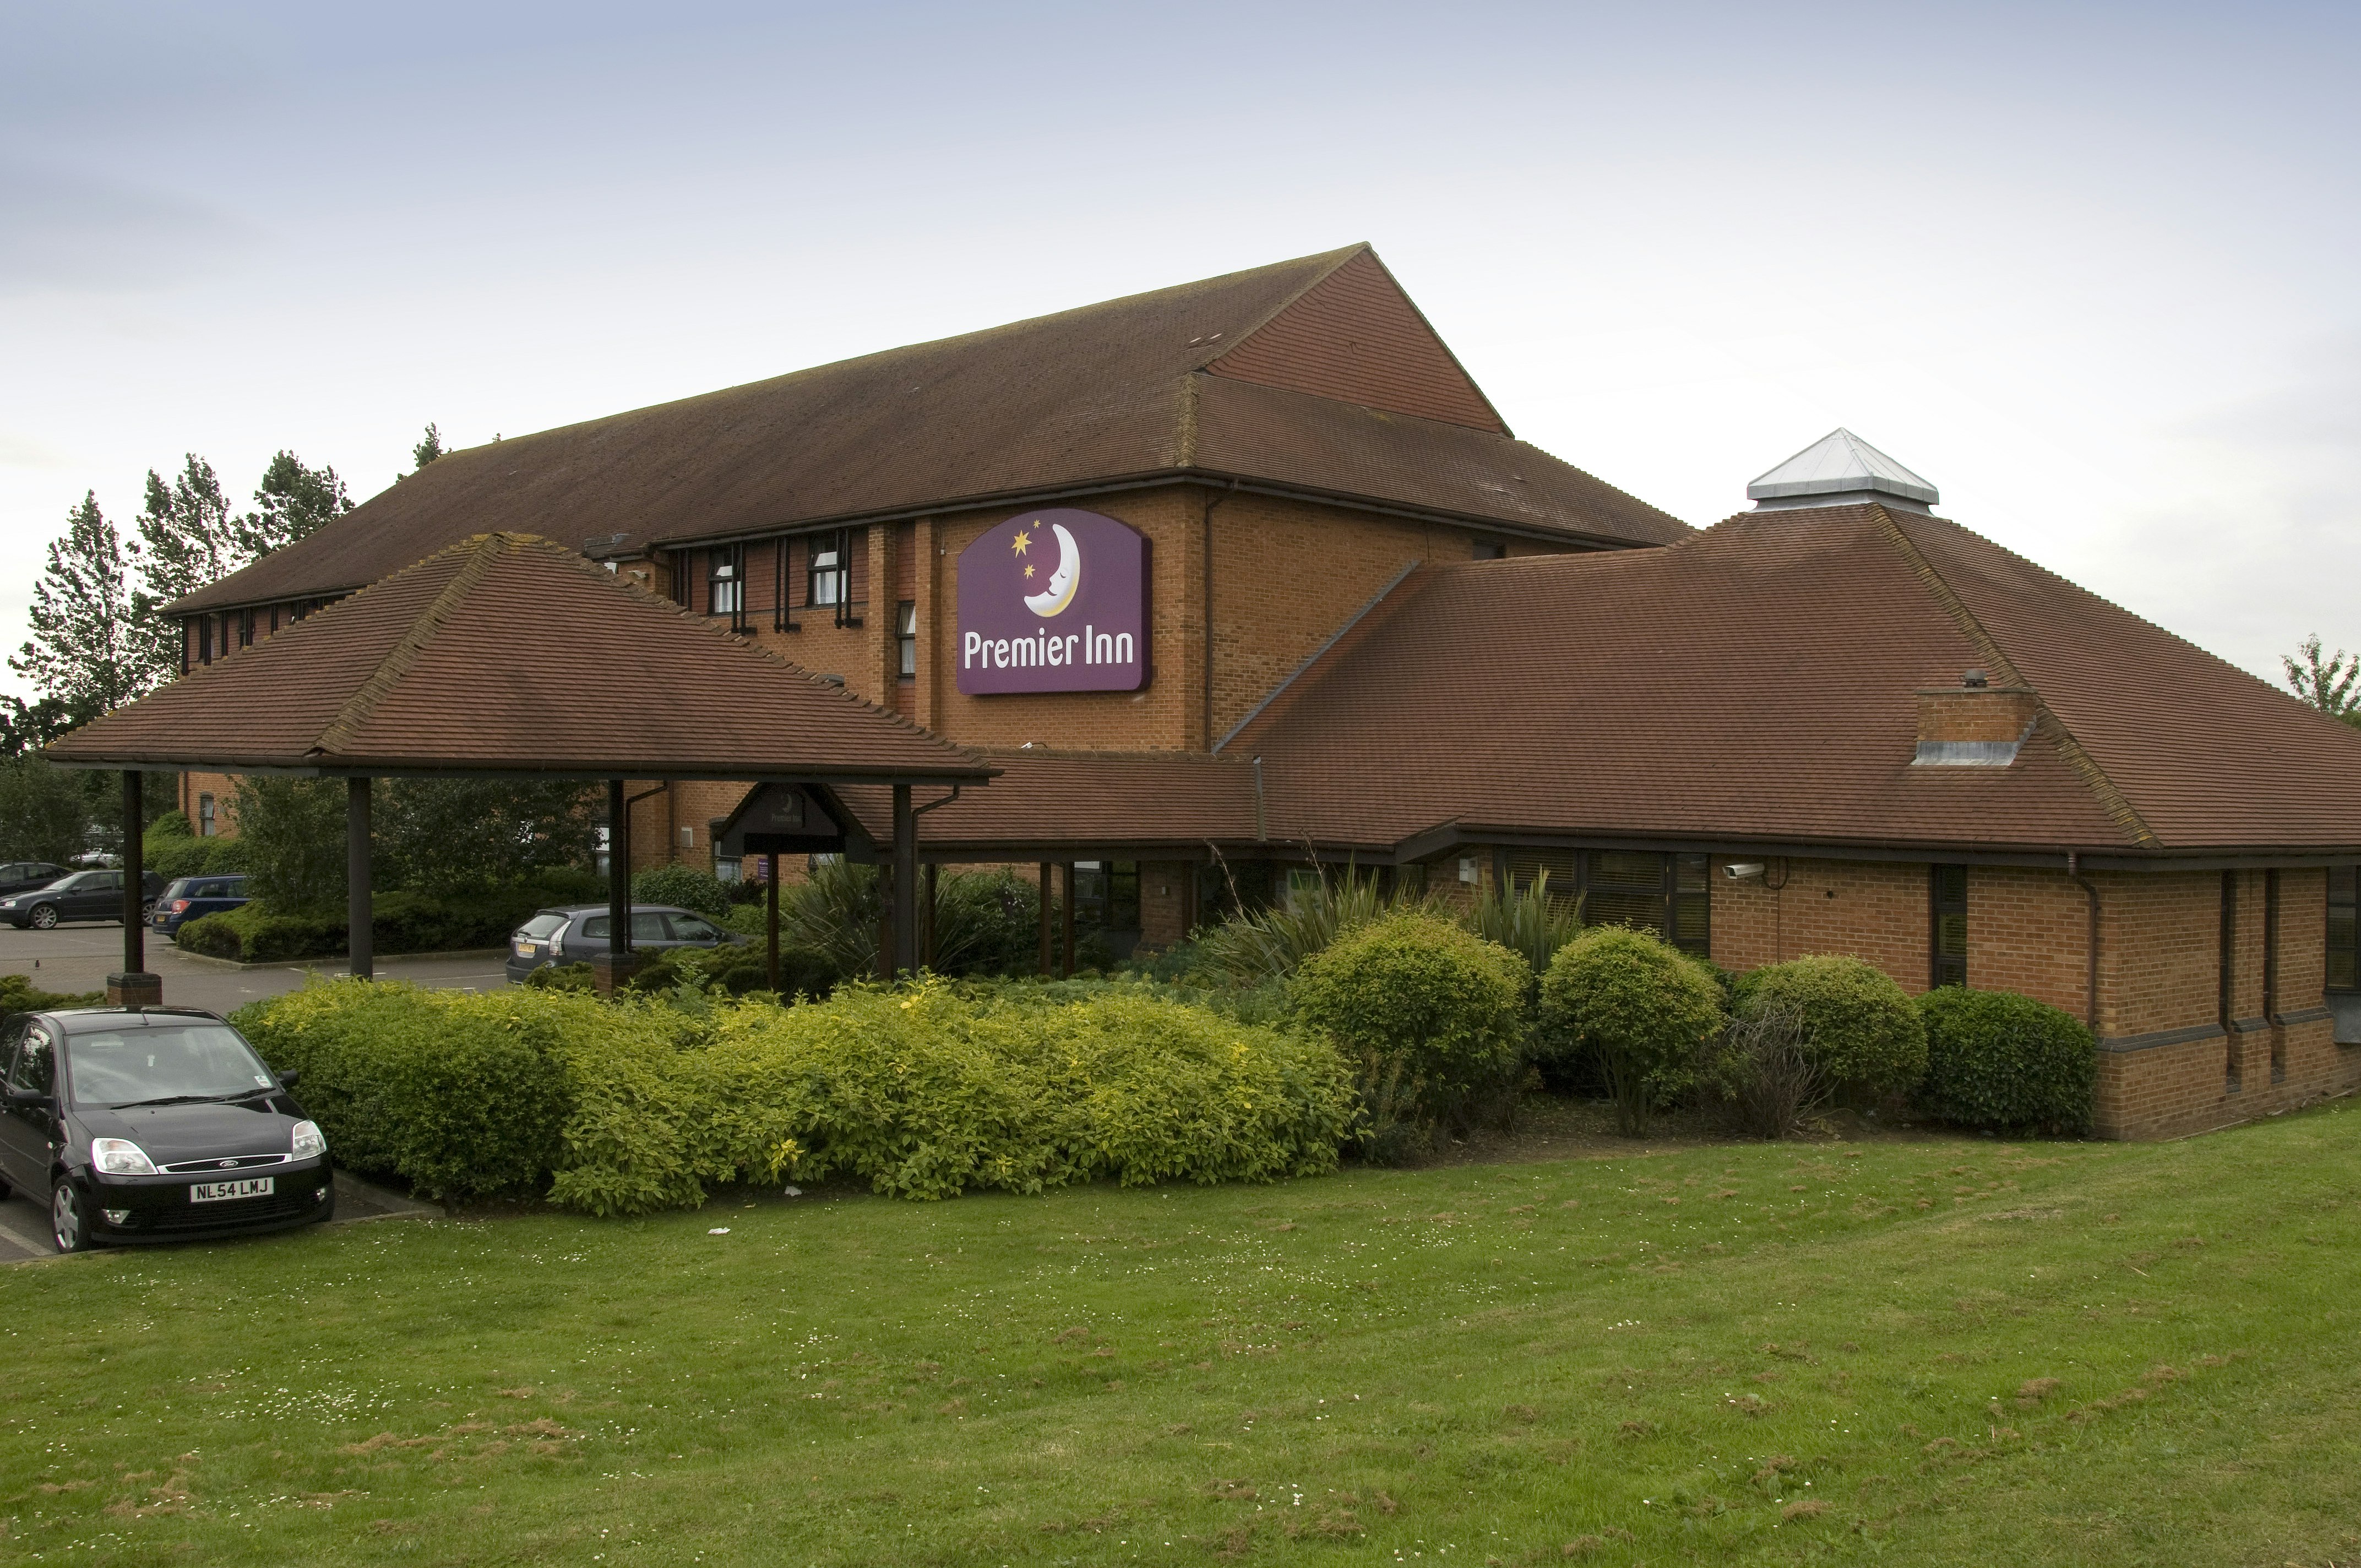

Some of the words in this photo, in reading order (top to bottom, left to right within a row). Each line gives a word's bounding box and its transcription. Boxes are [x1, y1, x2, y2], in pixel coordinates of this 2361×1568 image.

[965, 627, 1079, 669] Premier
[1085, 624, 1133, 665] Inn
[771, 813, 791, 822] Premier
[792, 814, 801, 822] Inn
[197, 1183, 236, 1199] NL54
[240, 1179, 268, 1195] LMJ
